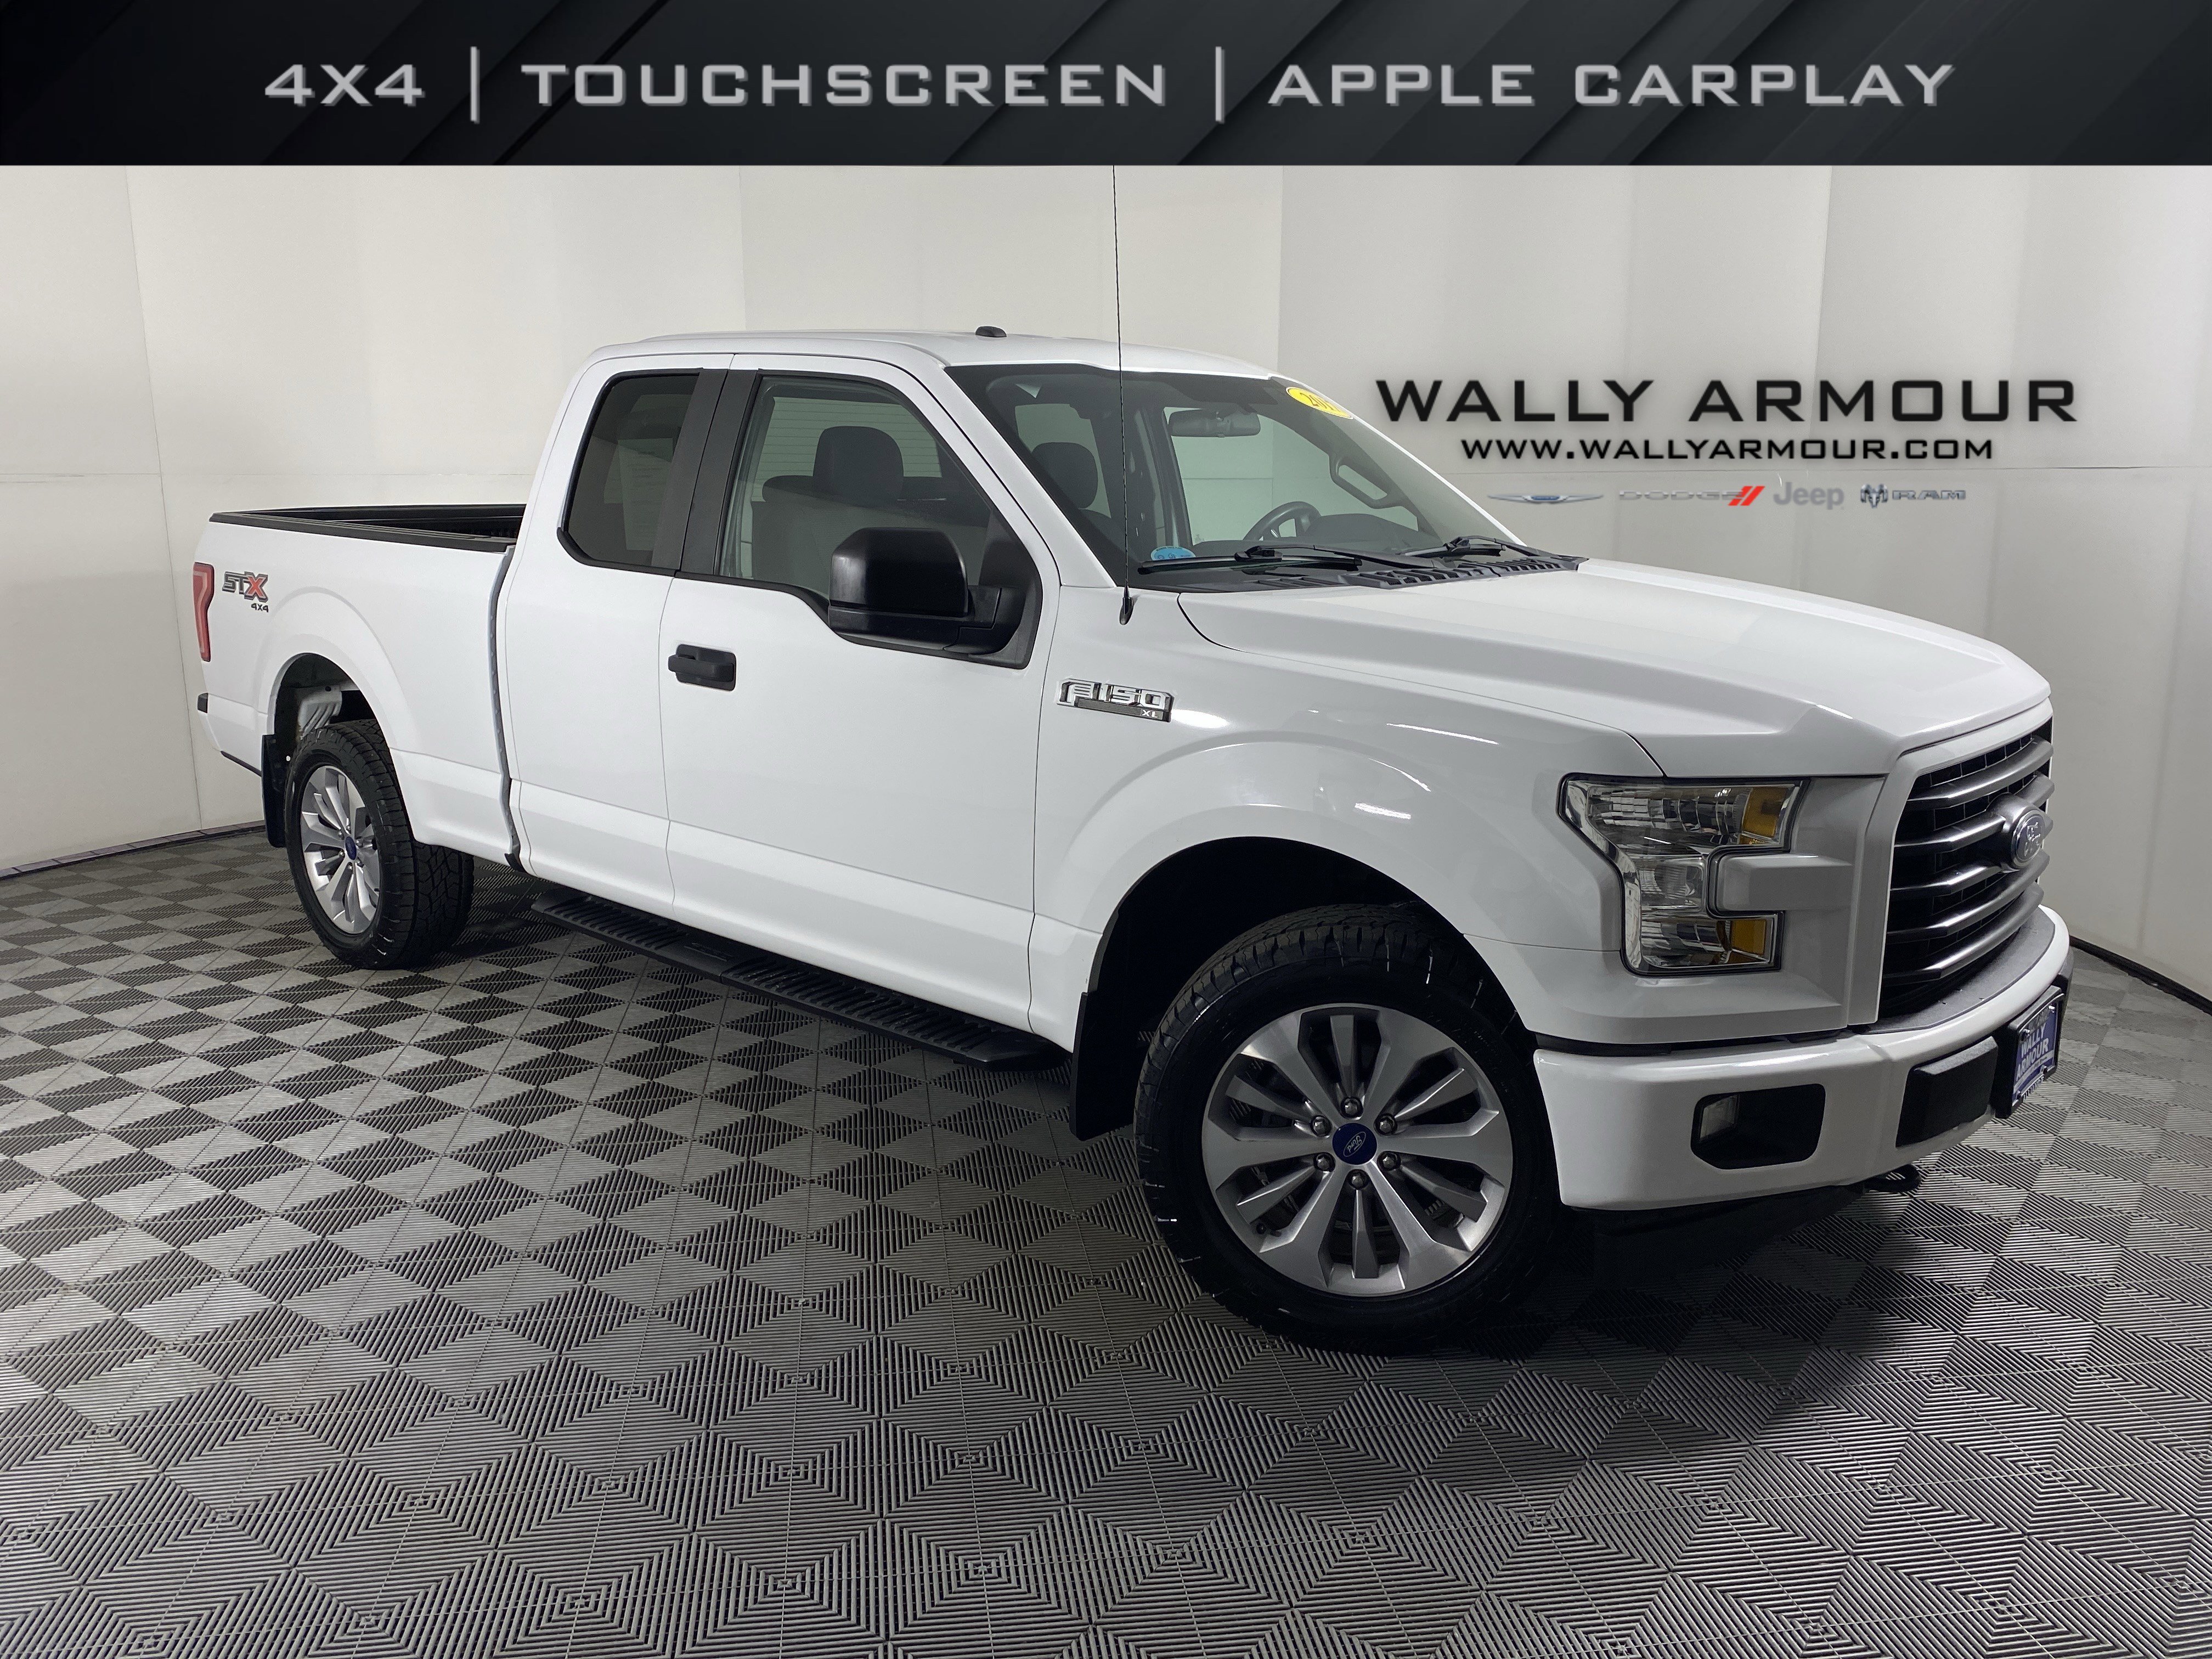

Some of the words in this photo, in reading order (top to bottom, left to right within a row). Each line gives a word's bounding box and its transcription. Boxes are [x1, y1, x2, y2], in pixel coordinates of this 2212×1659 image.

[1375, 380, 1654, 422] WALLY
[1688, 380, 2077, 422] ARMOUR
[1461, 439, 1992, 460] WWW.WALLYARMOUR.COM
[1619, 490, 1743, 500] DODGE
[1773, 482, 1845, 511] Jeep
[1892, 490, 1966, 500] RAM
[222, 571, 269, 602] STX
[1141, 709, 1158, 719] XL
[2021, 1022, 2047, 1059] WALLY
[2015, 1037, 2050, 1081] ARMOUR
[1346, 1135, 1362, 1153] Ford
